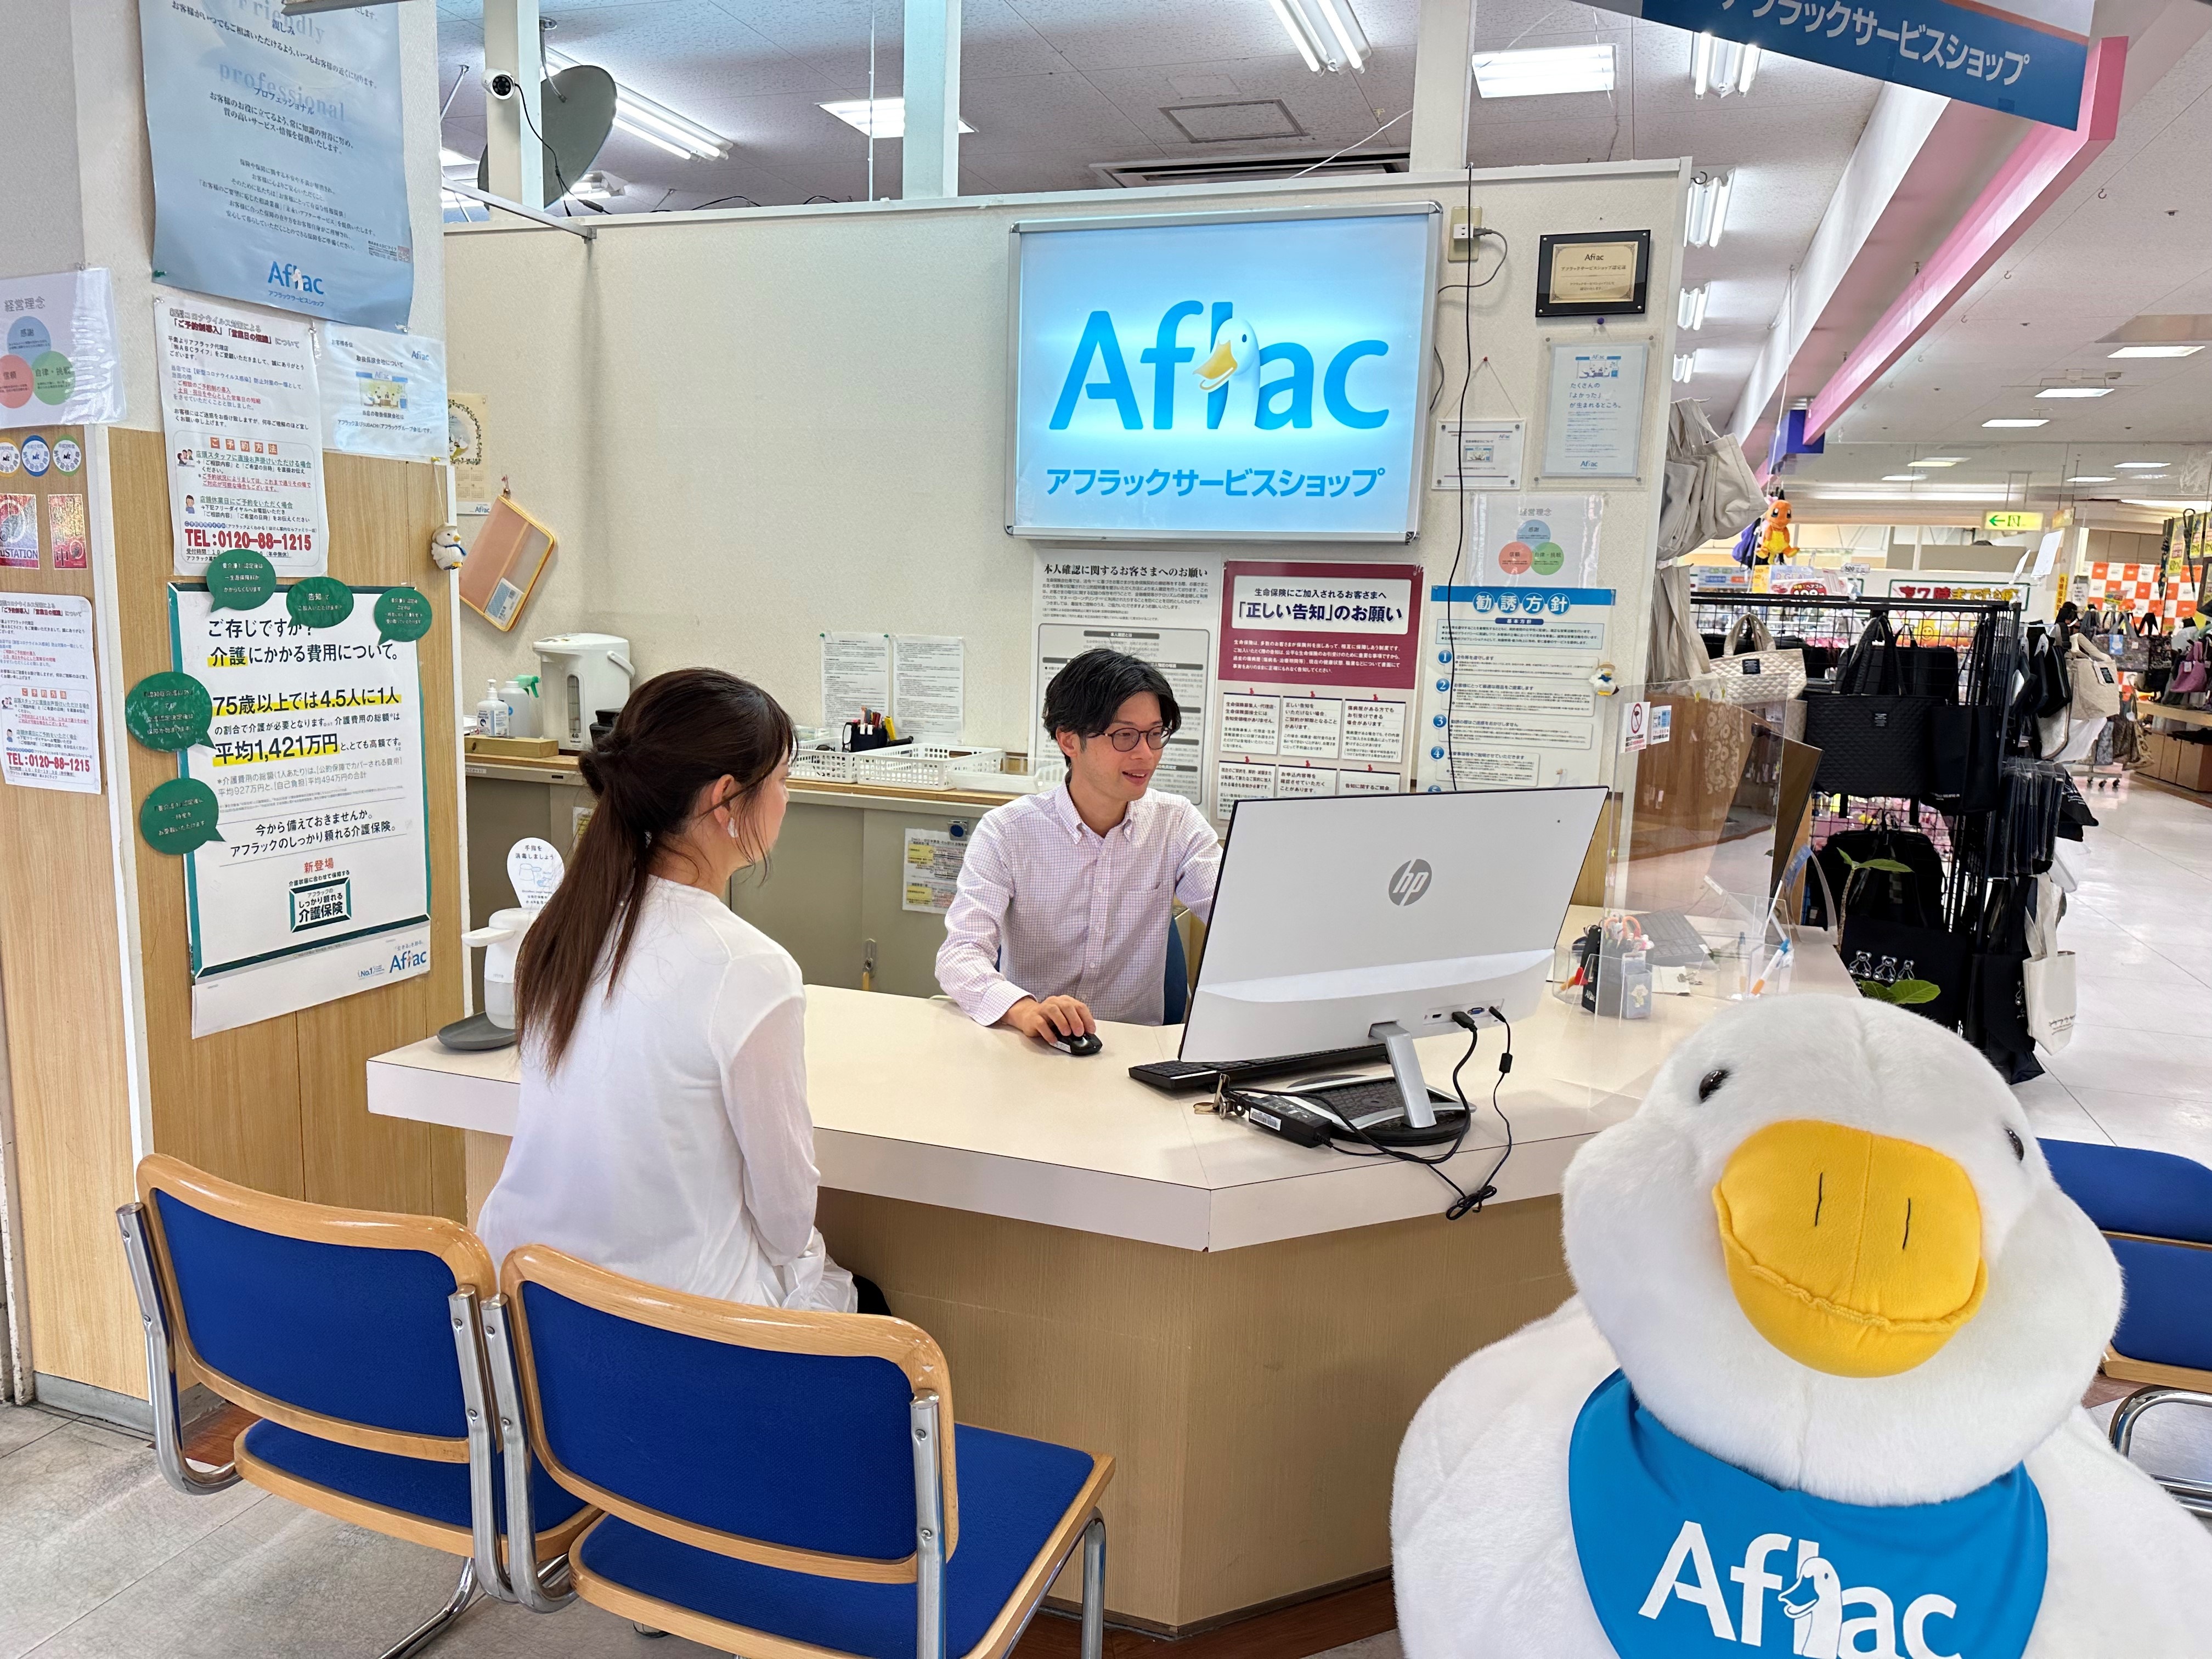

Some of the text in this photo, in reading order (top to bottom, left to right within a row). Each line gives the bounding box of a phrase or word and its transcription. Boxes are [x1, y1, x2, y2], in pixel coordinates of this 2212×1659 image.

[272, 18, 295, 36] 親しみ
[1722, 0, 2030, 85] フラックサービスショップ
[219, 63, 345, 121] professional
[253, 87, 314, 115] プロフェッショナル
[4, 296, 46, 312] 経営理念
[1048, 300, 1390, 430] Aflac
[1046, 467, 1386, 498] アフラックサービスショップ
[1043, 563, 1207, 578] 本人確認に関するお客さまへのお願い
[1254, 588, 1386, 600] 生命保険にご加入されるお客さまへ
[1475, 594, 1568, 613] 勧誘方針
[1238, 601, 1402, 623] 「正しい告知」のお願い
[210, 642, 398, 667] 介護にかかる費用について。
[212, 686, 400, 716] 75歳以上では4.5人に1人
[213, 732, 338, 764] 平均1,421万円
[255, 809, 373, 837] 今から備えておきませんか。
[230, 821, 397, 857] アフラックのしっかり頼れる介護保険。
[303, 857, 335, 873] 新登場
[1392, 859, 1429, 906] hp
[298, 892, 343, 909] しっかり頼れる
[298, 901, 343, 923] 介護保険
[1638, 1520, 1962, 1659] Aflac
